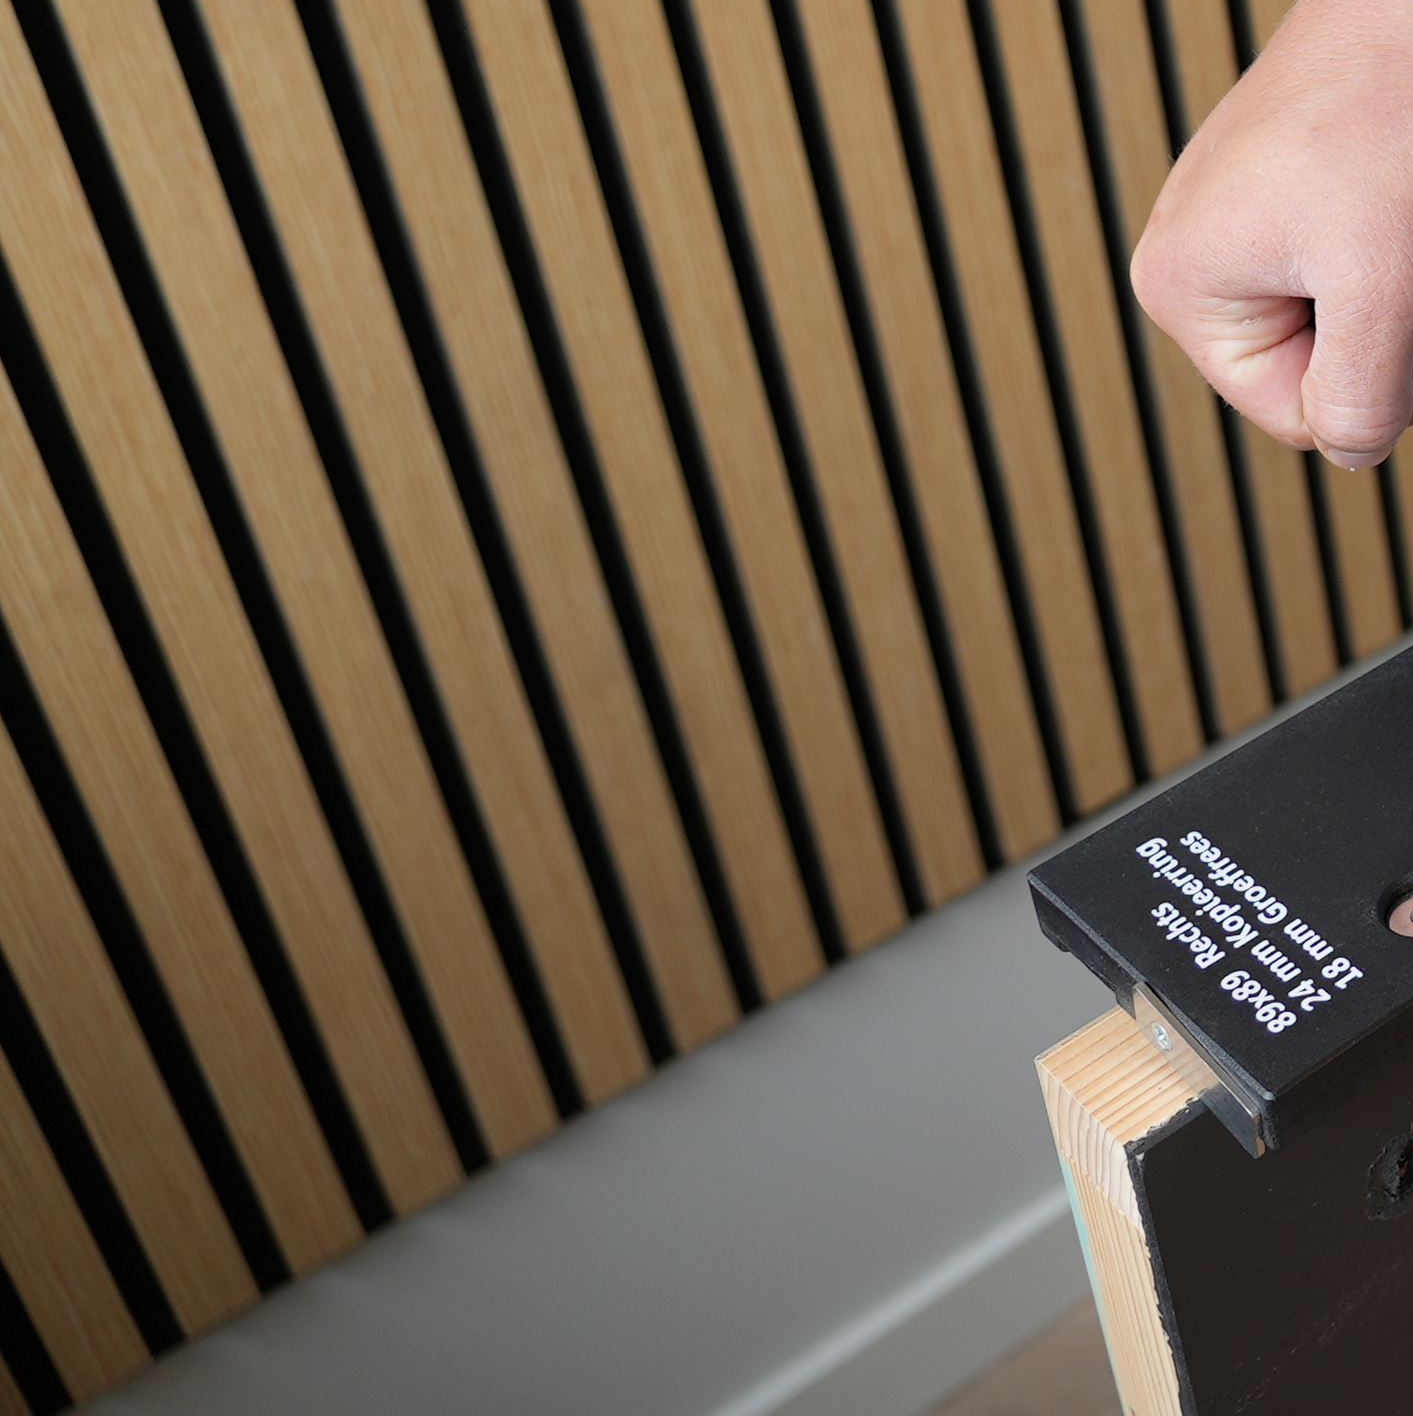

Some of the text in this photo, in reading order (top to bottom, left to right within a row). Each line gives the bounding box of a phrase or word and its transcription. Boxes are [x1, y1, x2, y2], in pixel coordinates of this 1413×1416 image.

[1136, 838, 1332, 1012] 24 mm Kopieerring
[1151, 903, 1297, 1034] 89x89 Rechts
[1180, 831, 1364, 990] 18 mm Groeffrees
